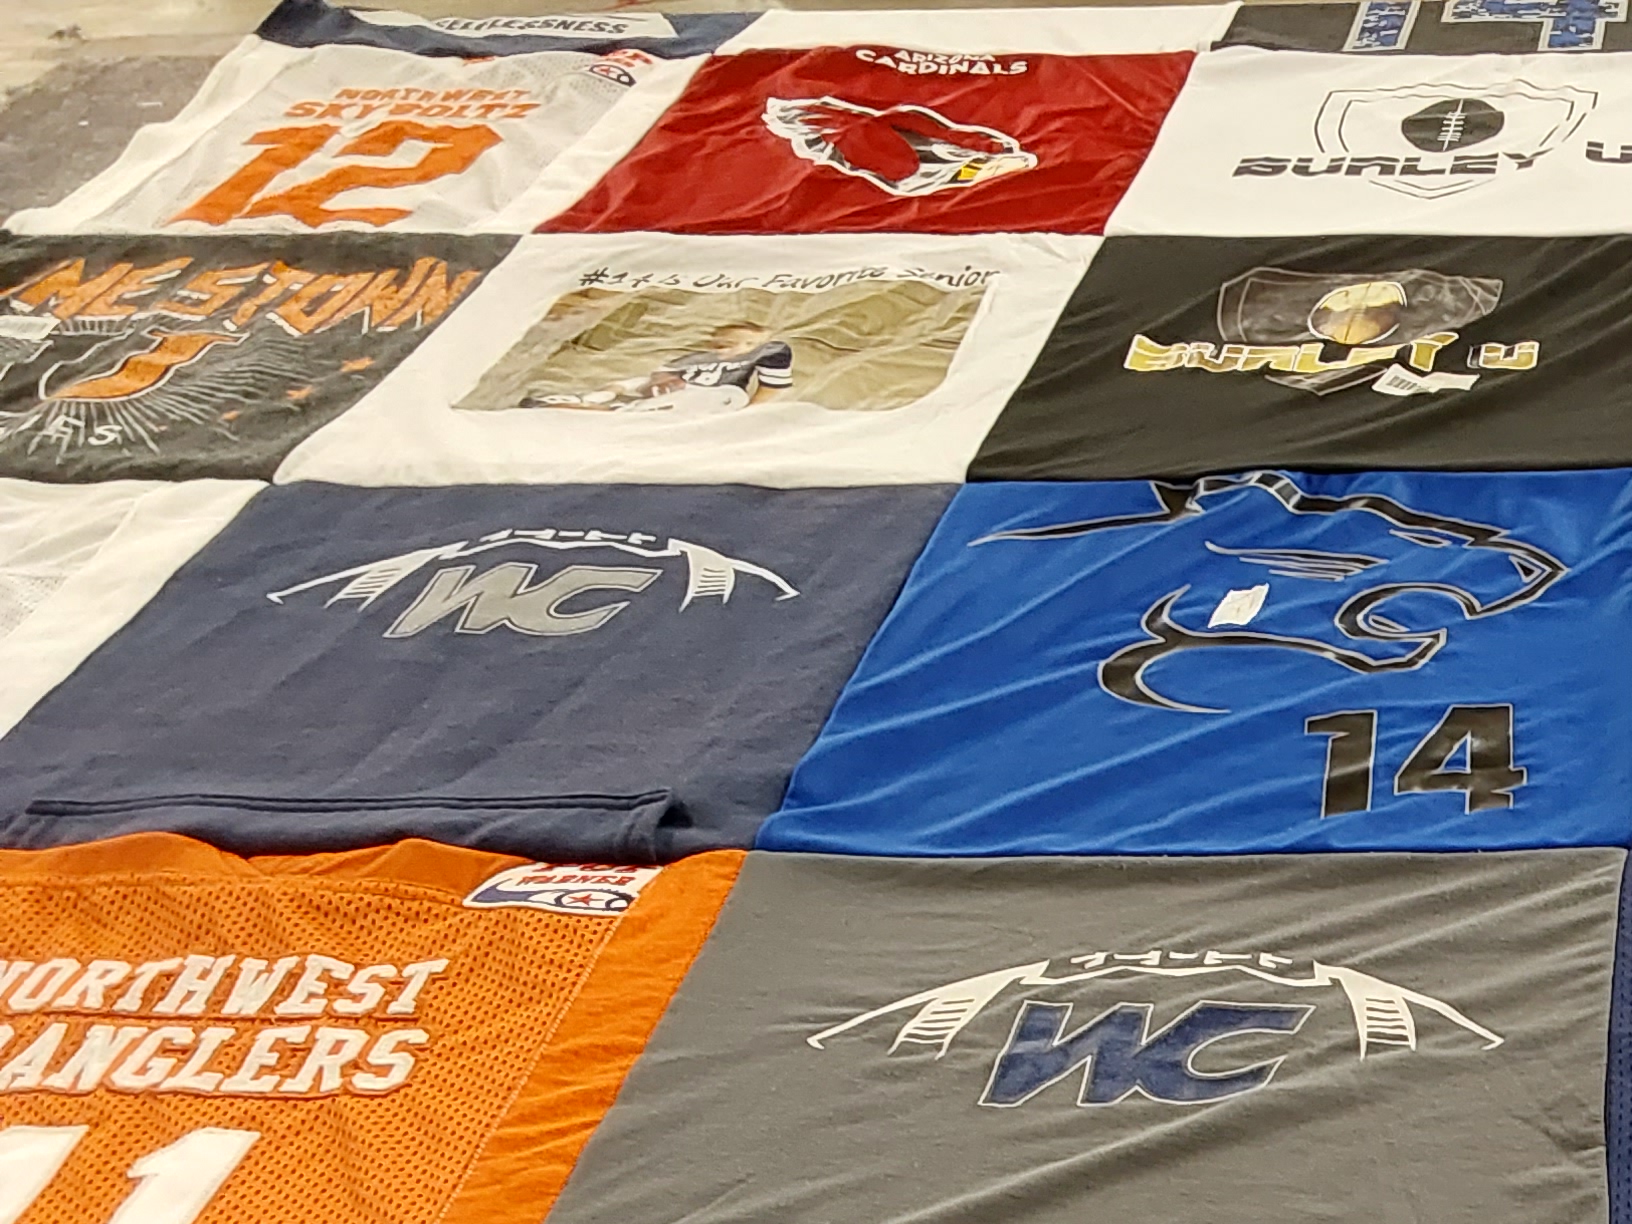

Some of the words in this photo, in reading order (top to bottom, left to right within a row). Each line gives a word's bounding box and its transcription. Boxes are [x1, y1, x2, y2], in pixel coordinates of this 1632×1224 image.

[855, 49, 1028, 75] CARDINALS
[284, 101, 542, 119] SKYBOLTZ
[165, 119, 503, 228] 12
[1304, 702, 1528, 820] 14
[0, 1022, 430, 1094] ANGLERS
